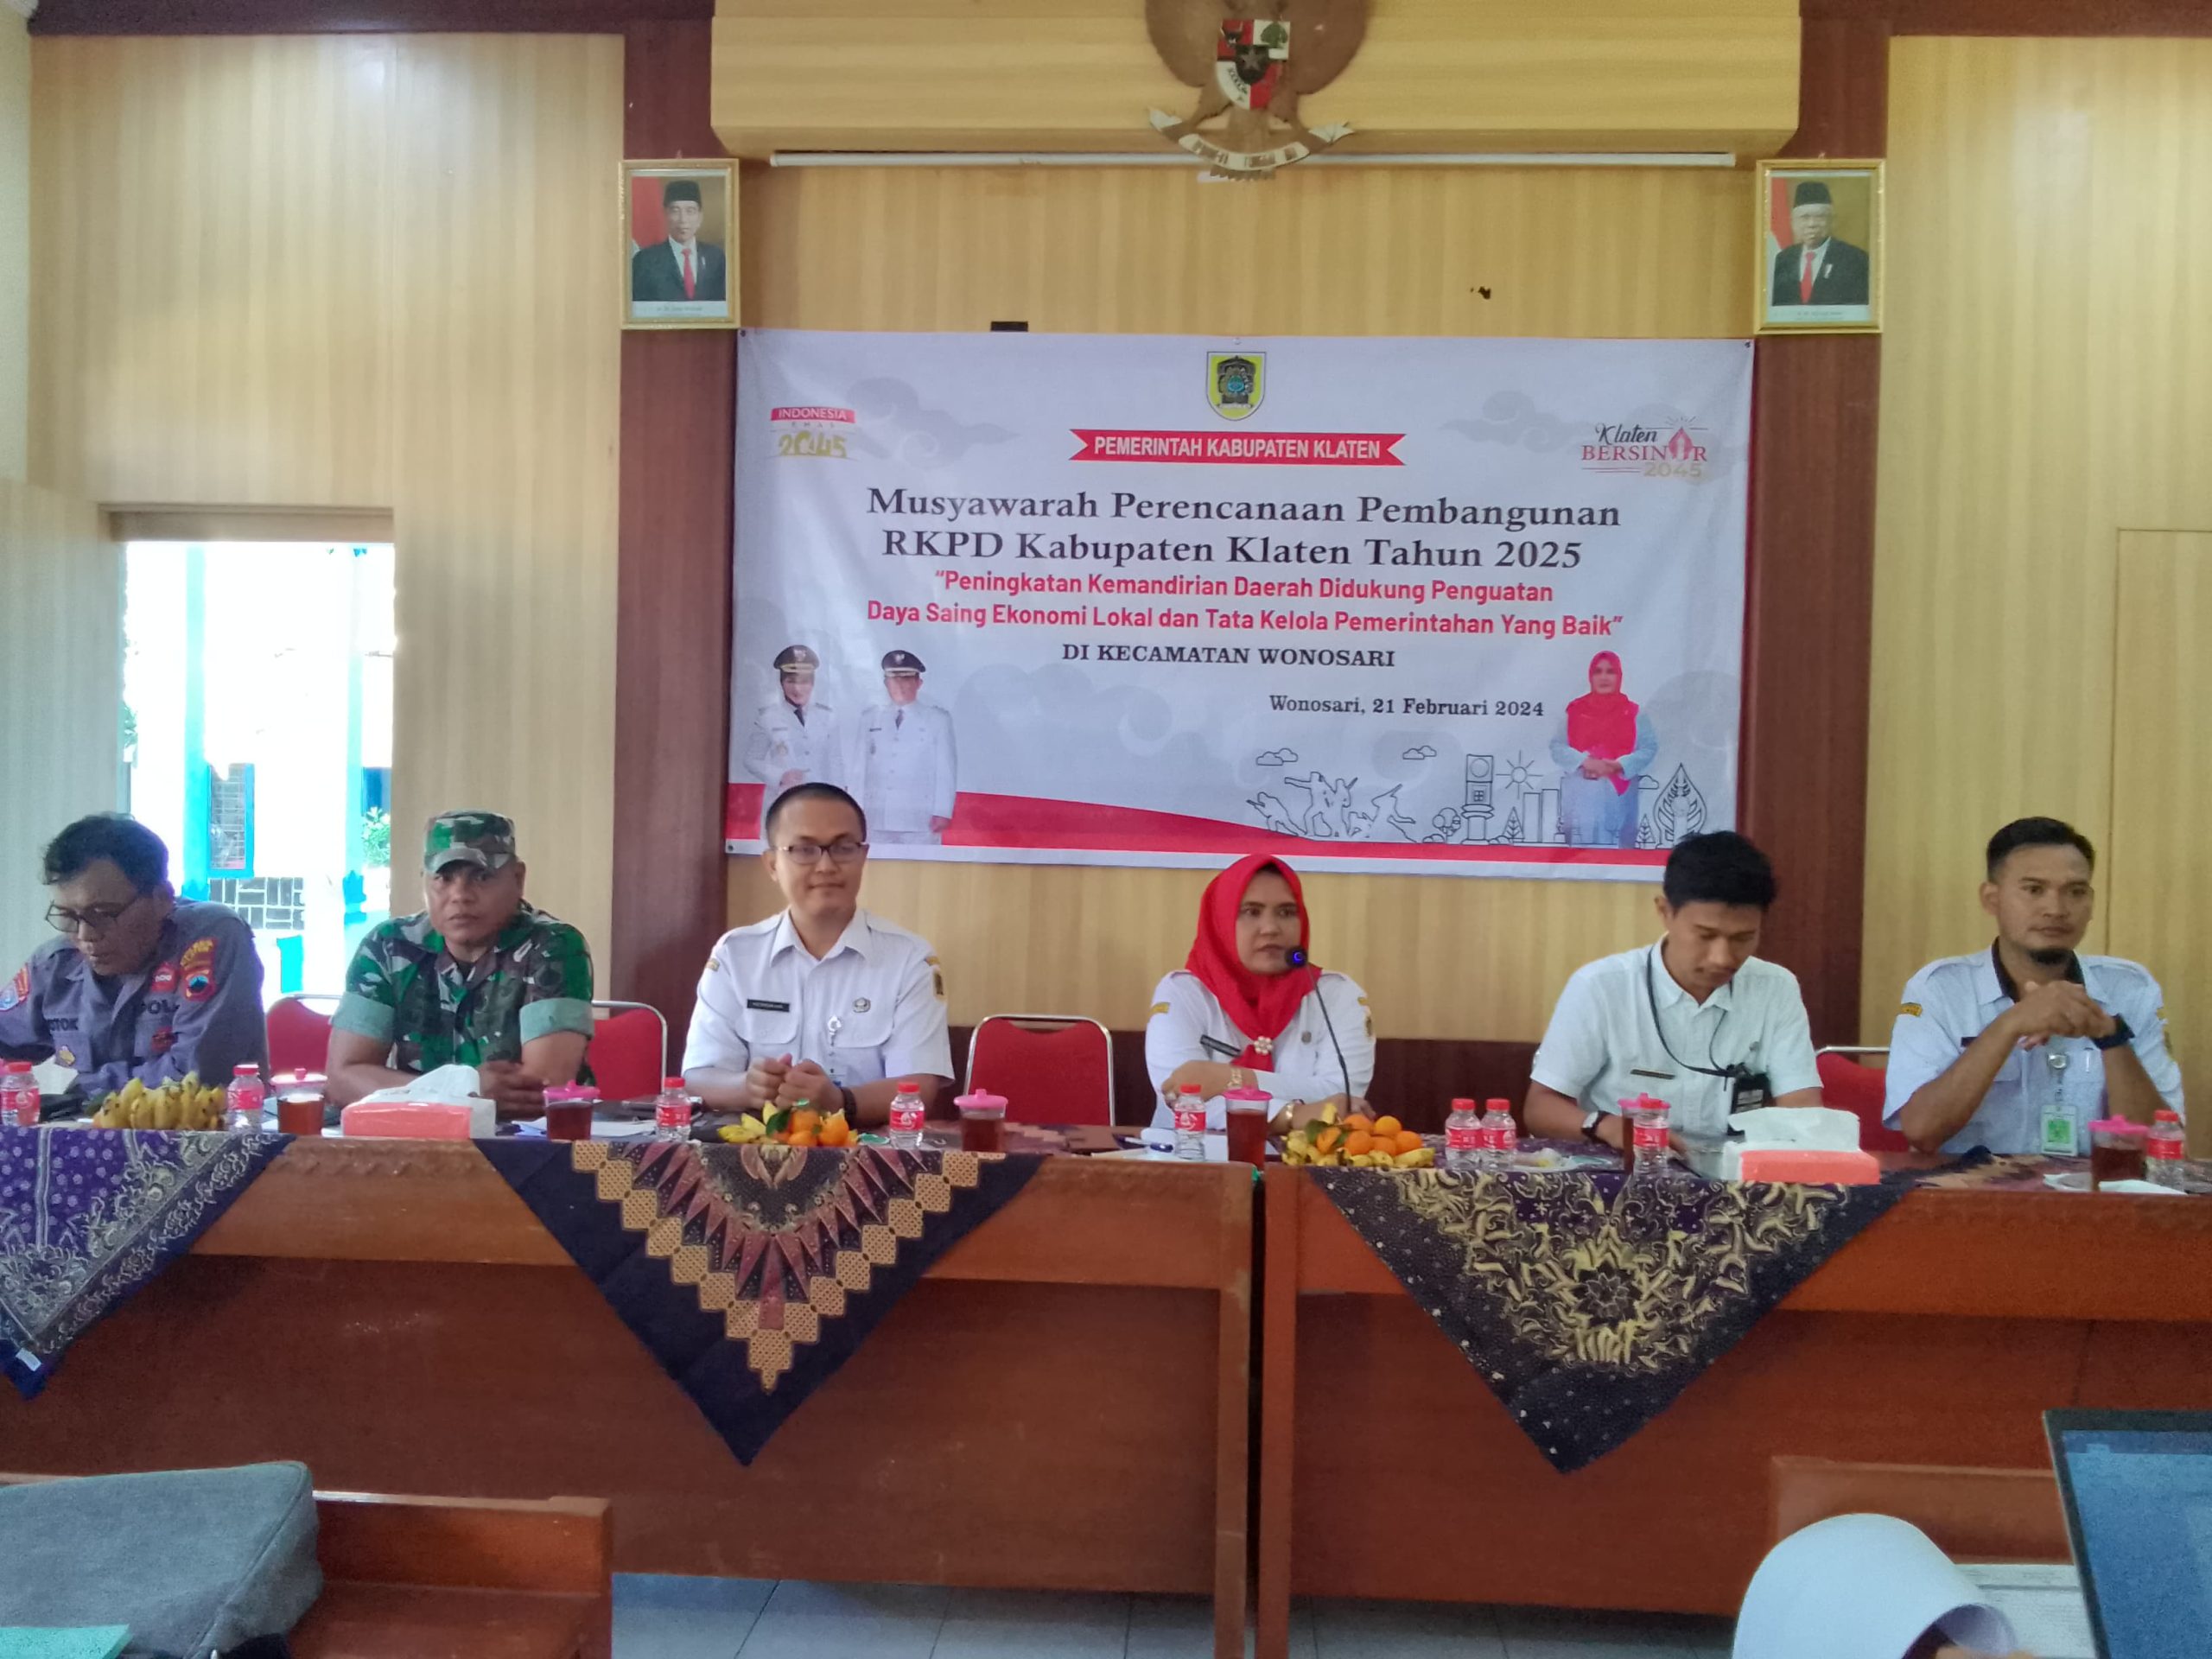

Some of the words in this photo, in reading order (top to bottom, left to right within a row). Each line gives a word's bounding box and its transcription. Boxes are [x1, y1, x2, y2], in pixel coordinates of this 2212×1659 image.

[779, 408, 847, 420] INDONESIA
[1595, 423, 1658, 445] Klaten
[1094, 436, 1202, 456] PEMERINTAH
[1207, 438, 1309, 458] KABUPATEN
[1313, 440, 1380, 459] KLATEN
[1643, 461, 1703, 478] 2045
[867, 487, 1099, 523] Musyawarah
[1111, 493, 1345, 522] Perencanaan
[1357, 496, 1621, 532] Pembangunan
[882, 529, 1003, 558] RKPD
[1016, 533, 1214, 568] Kabupaten
[1227, 536, 1351, 564] Klaten
[1364, 538, 1482, 567] Tahun
[1494, 541, 1582, 569] 2025
[1087, 575, 1229, 596] Kemandirian
[1233, 576, 1313, 598] Daerah
[1319, 577, 1427, 604] Didukung
[1431, 580, 1554, 606] Penguatan
[868, 600, 921, 626] Daya
[925, 601, 988, 629] Saing
[992, 604, 1087, 626] Ekonomi
[1092, 607, 1154, 627] Lokal
[1157, 608, 1199, 628] dan
[1206, 607, 1255, 630] Tata
[1259, 611, 1329, 631] Kelola
[1333, 611, 1495, 634] Pemerintahan
[1502, 616, 1557, 640] Yang
[1062, 644, 1090, 660] DI
[1096, 645, 1250, 664] KECAMATAN
[1257, 648, 1395, 667] WONOSARI
[1268, 695, 1366, 715] Wonosari,
[1372, 698, 1395, 714] 21
[1402, 697, 1488, 715] Februari
[1495, 700, 1544, 717] 2024
